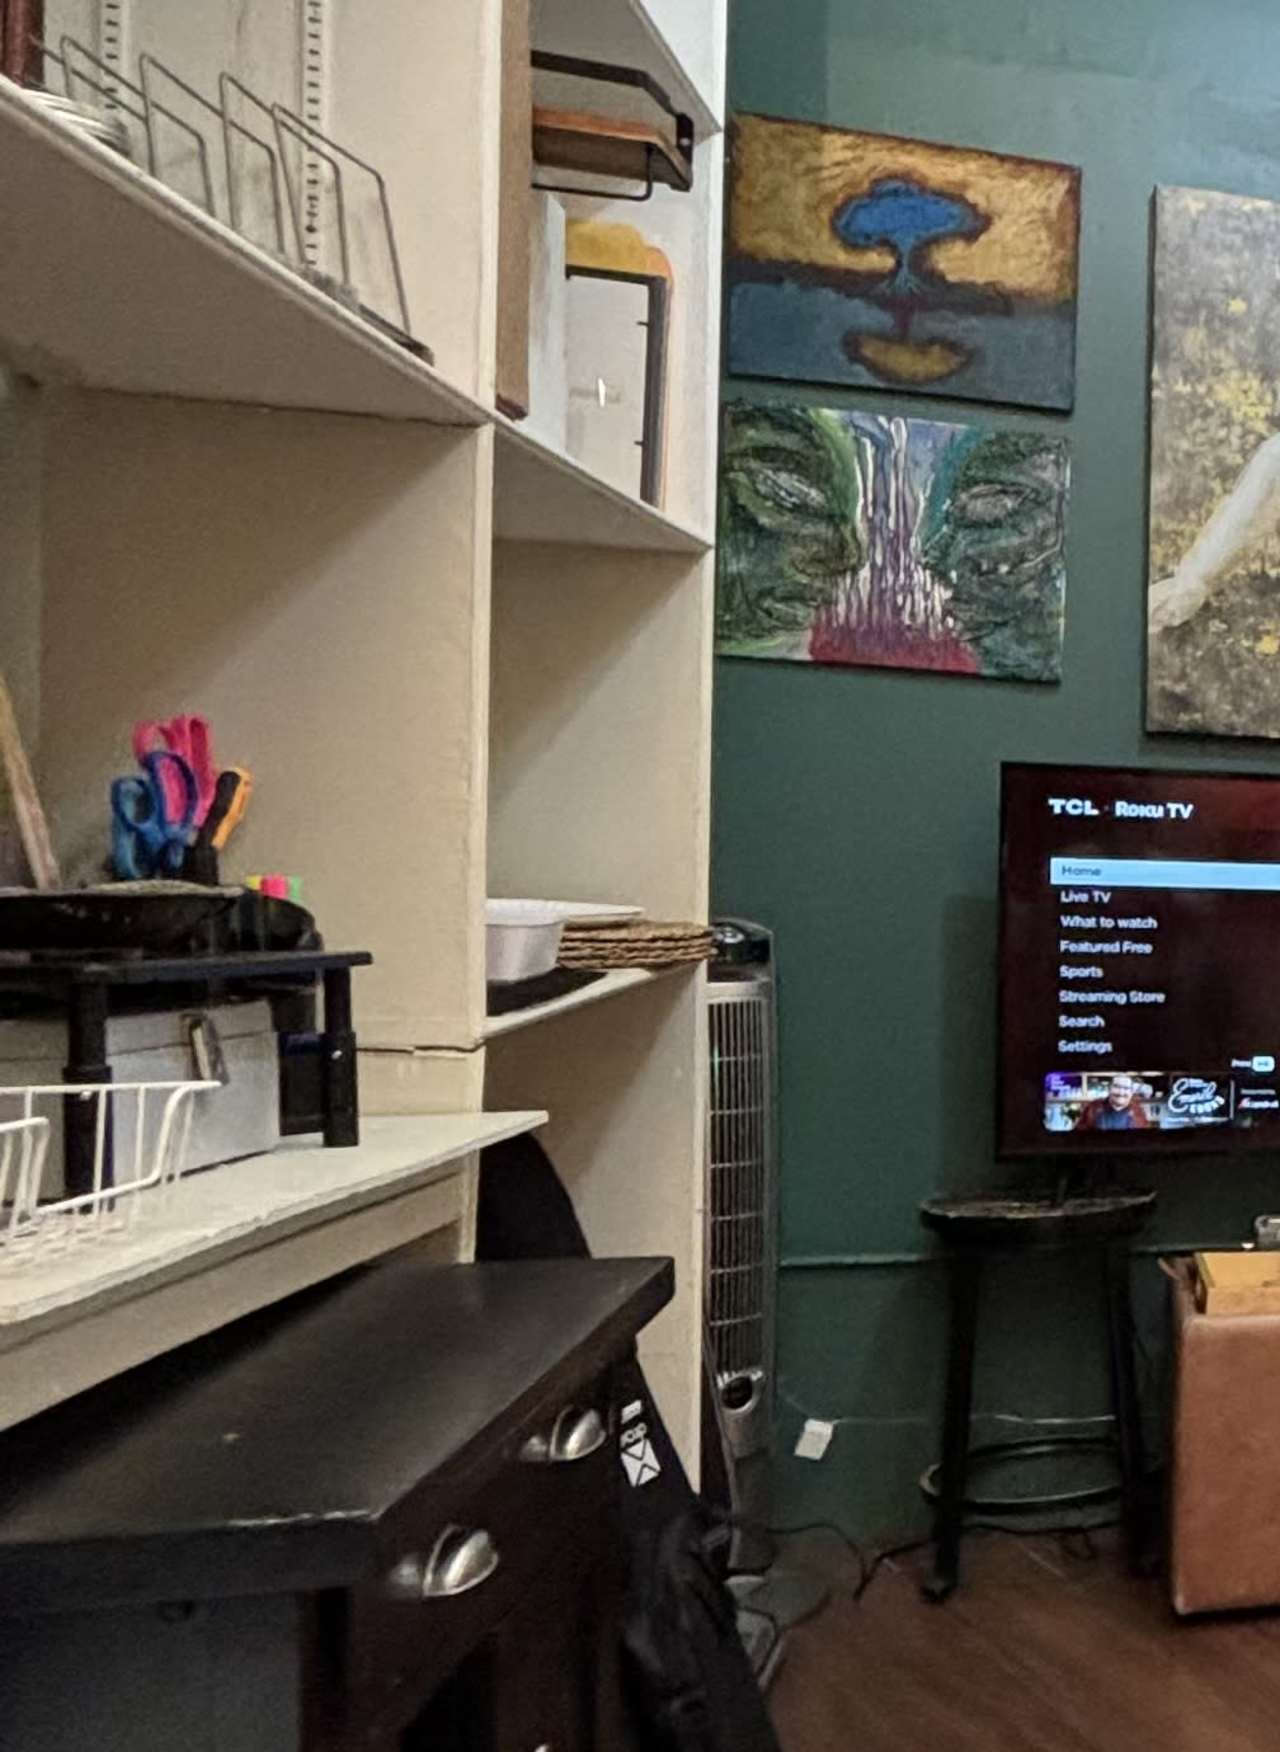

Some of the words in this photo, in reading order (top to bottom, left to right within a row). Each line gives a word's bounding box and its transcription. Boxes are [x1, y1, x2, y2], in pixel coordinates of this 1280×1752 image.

[1048, 798, 1099, 816] TCL
[1166, 802, 1194, 819] TV
[1061, 865, 1102, 877] Home
[1060, 890, 1089, 903] Live
[1092, 891, 1112, 903] TV
[1060, 915, 1097, 928] What
[1100, 916, 1115, 928] to
[1117, 916, 1158, 929] watch
[1060, 940, 1121, 953] Featured
[1122, 941, 1153, 954] Free
[1059, 965, 1103, 980] Sports
[1059, 990, 1127, 1005] Streaming
[1129, 990, 1166, 1003] Store
[1059, 1015, 1105, 1028] Search
[1058, 1040, 1112, 1055] Settings
